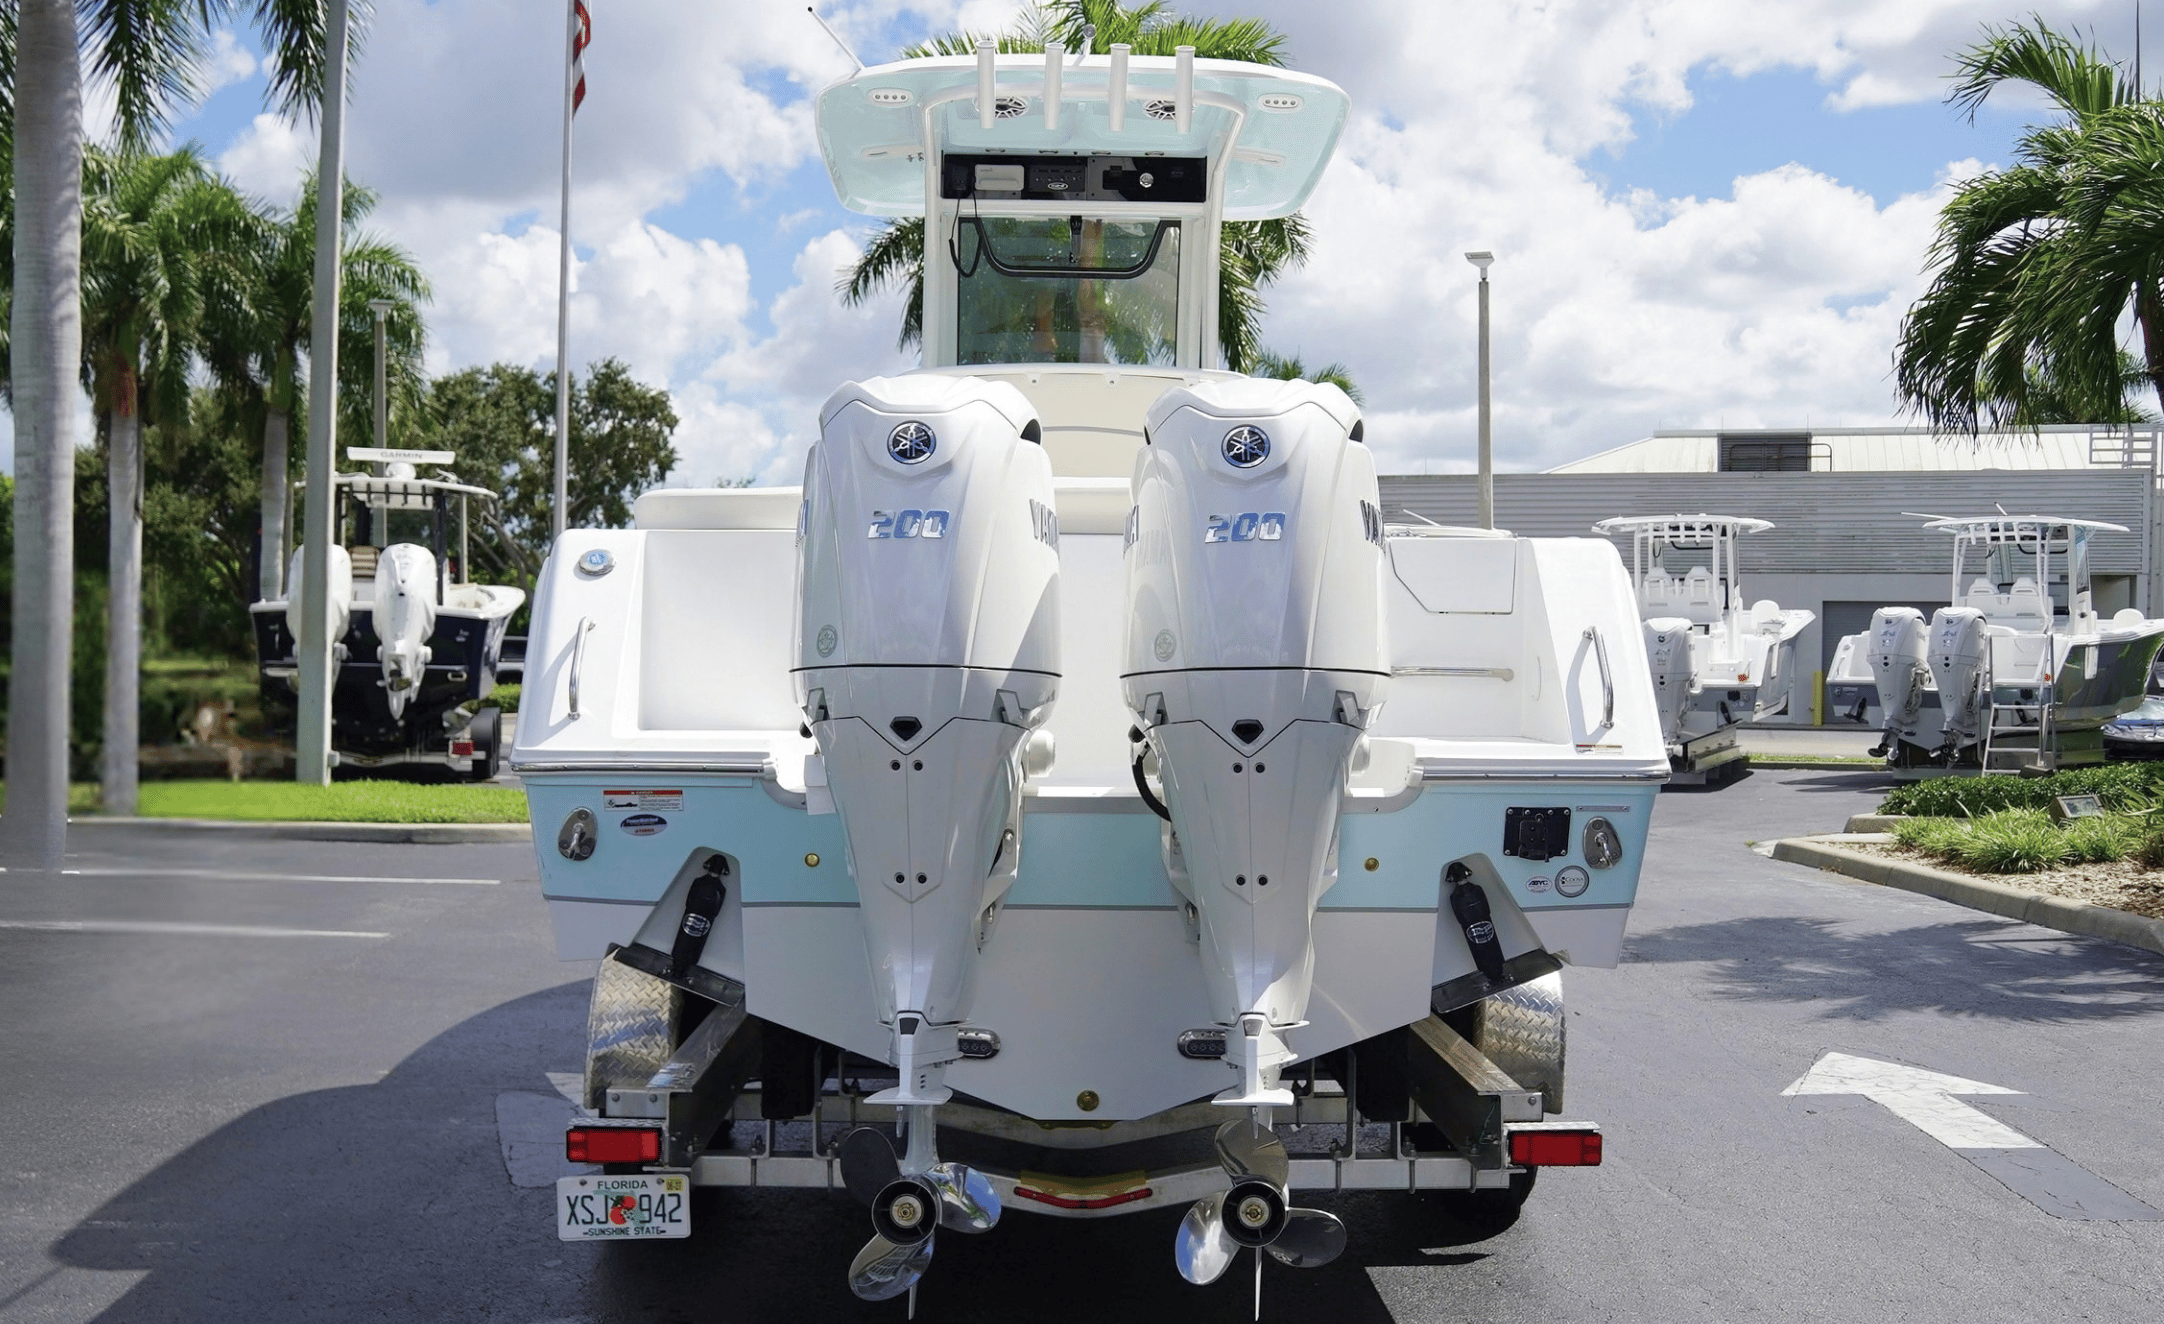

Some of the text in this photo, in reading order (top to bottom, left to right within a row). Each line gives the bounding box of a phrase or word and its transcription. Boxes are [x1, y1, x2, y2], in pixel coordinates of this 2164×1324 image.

[380, 450, 423, 459] GARMIN
[867, 509, 950, 539] 200
[1204, 511, 1286, 544] 200
[597, 1180, 649, 1190] FLORIDA
[566, 1193, 682, 1225] XSJ 942
[588, 1226, 661, 1236] SUNSHINE STATE
